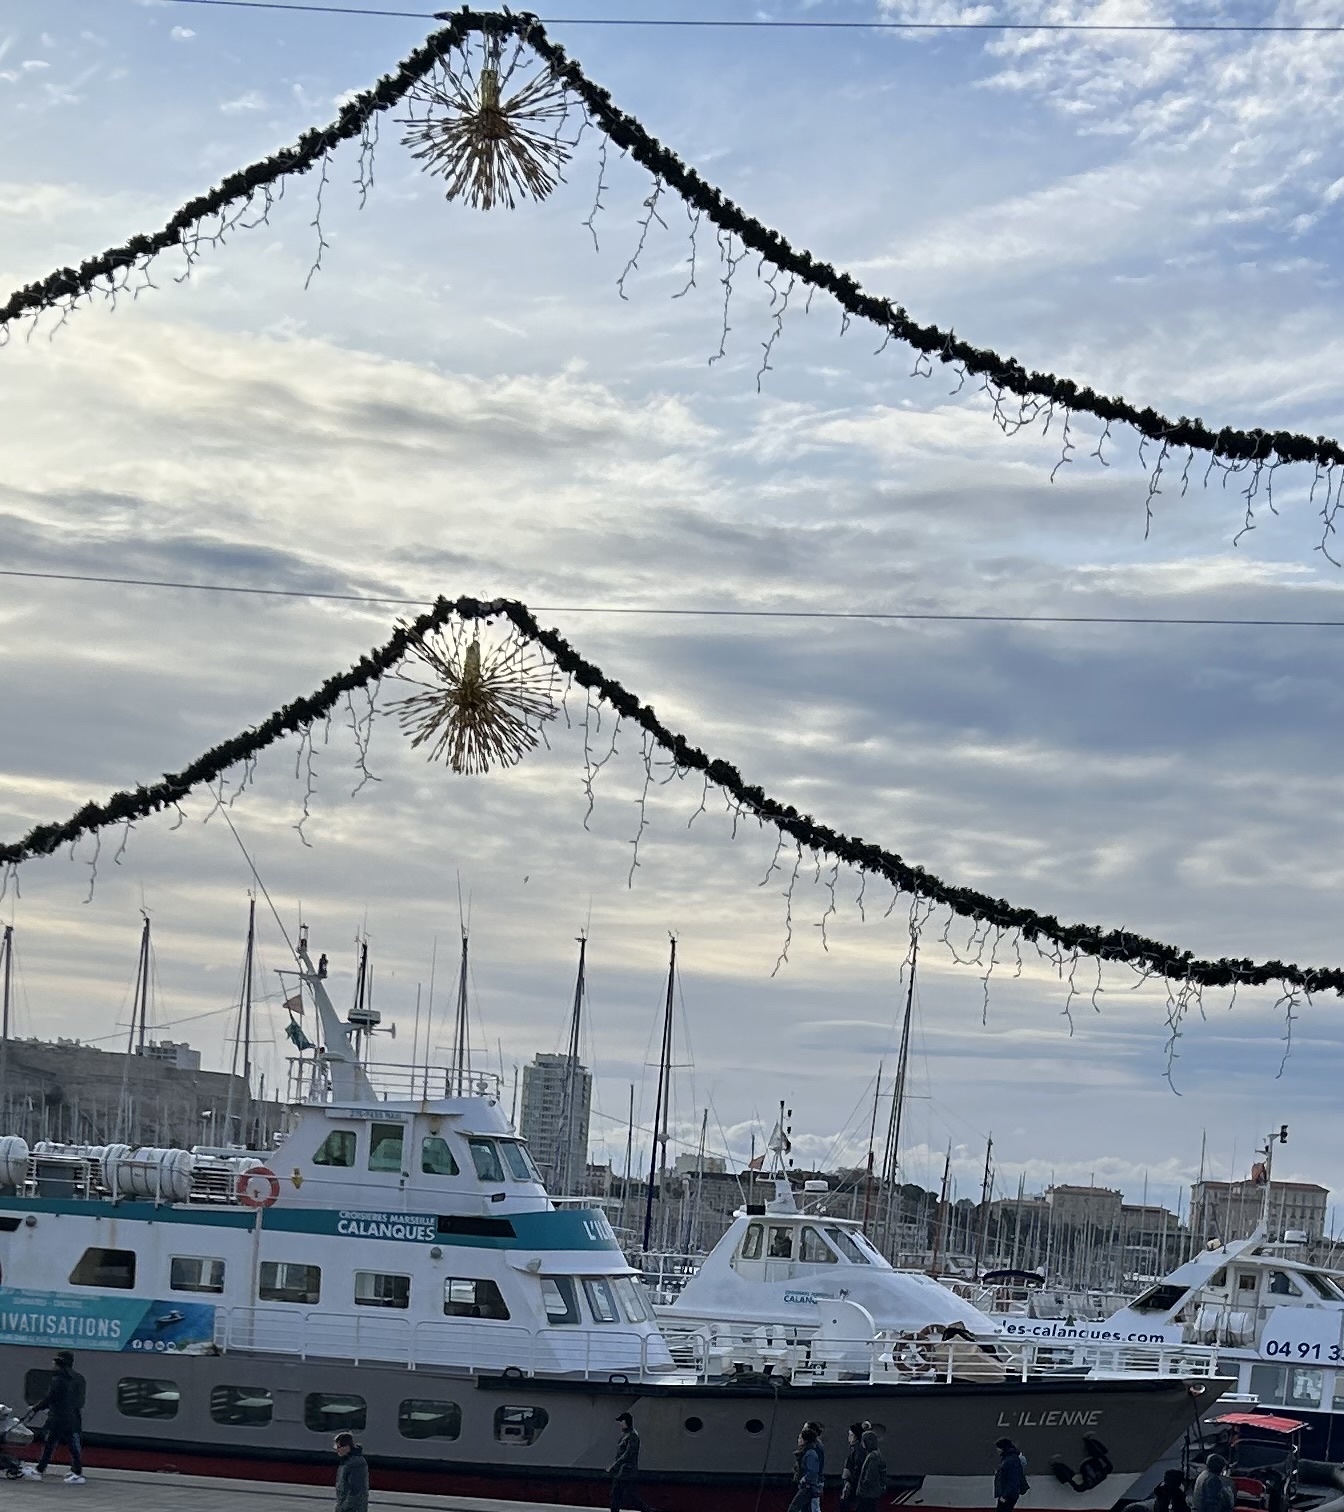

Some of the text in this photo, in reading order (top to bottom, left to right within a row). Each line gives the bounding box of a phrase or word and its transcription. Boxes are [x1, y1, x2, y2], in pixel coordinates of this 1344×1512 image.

[389, 1214, 436, 1226] MARSEILLE
[337, 1219, 436, 1242] CALANQUES
[1266, 1340, 1292, 1358] 04
[1297, 1342, 1322, 1360] 91
[996, 1410, 1104, 1428] L'ILIENNE
